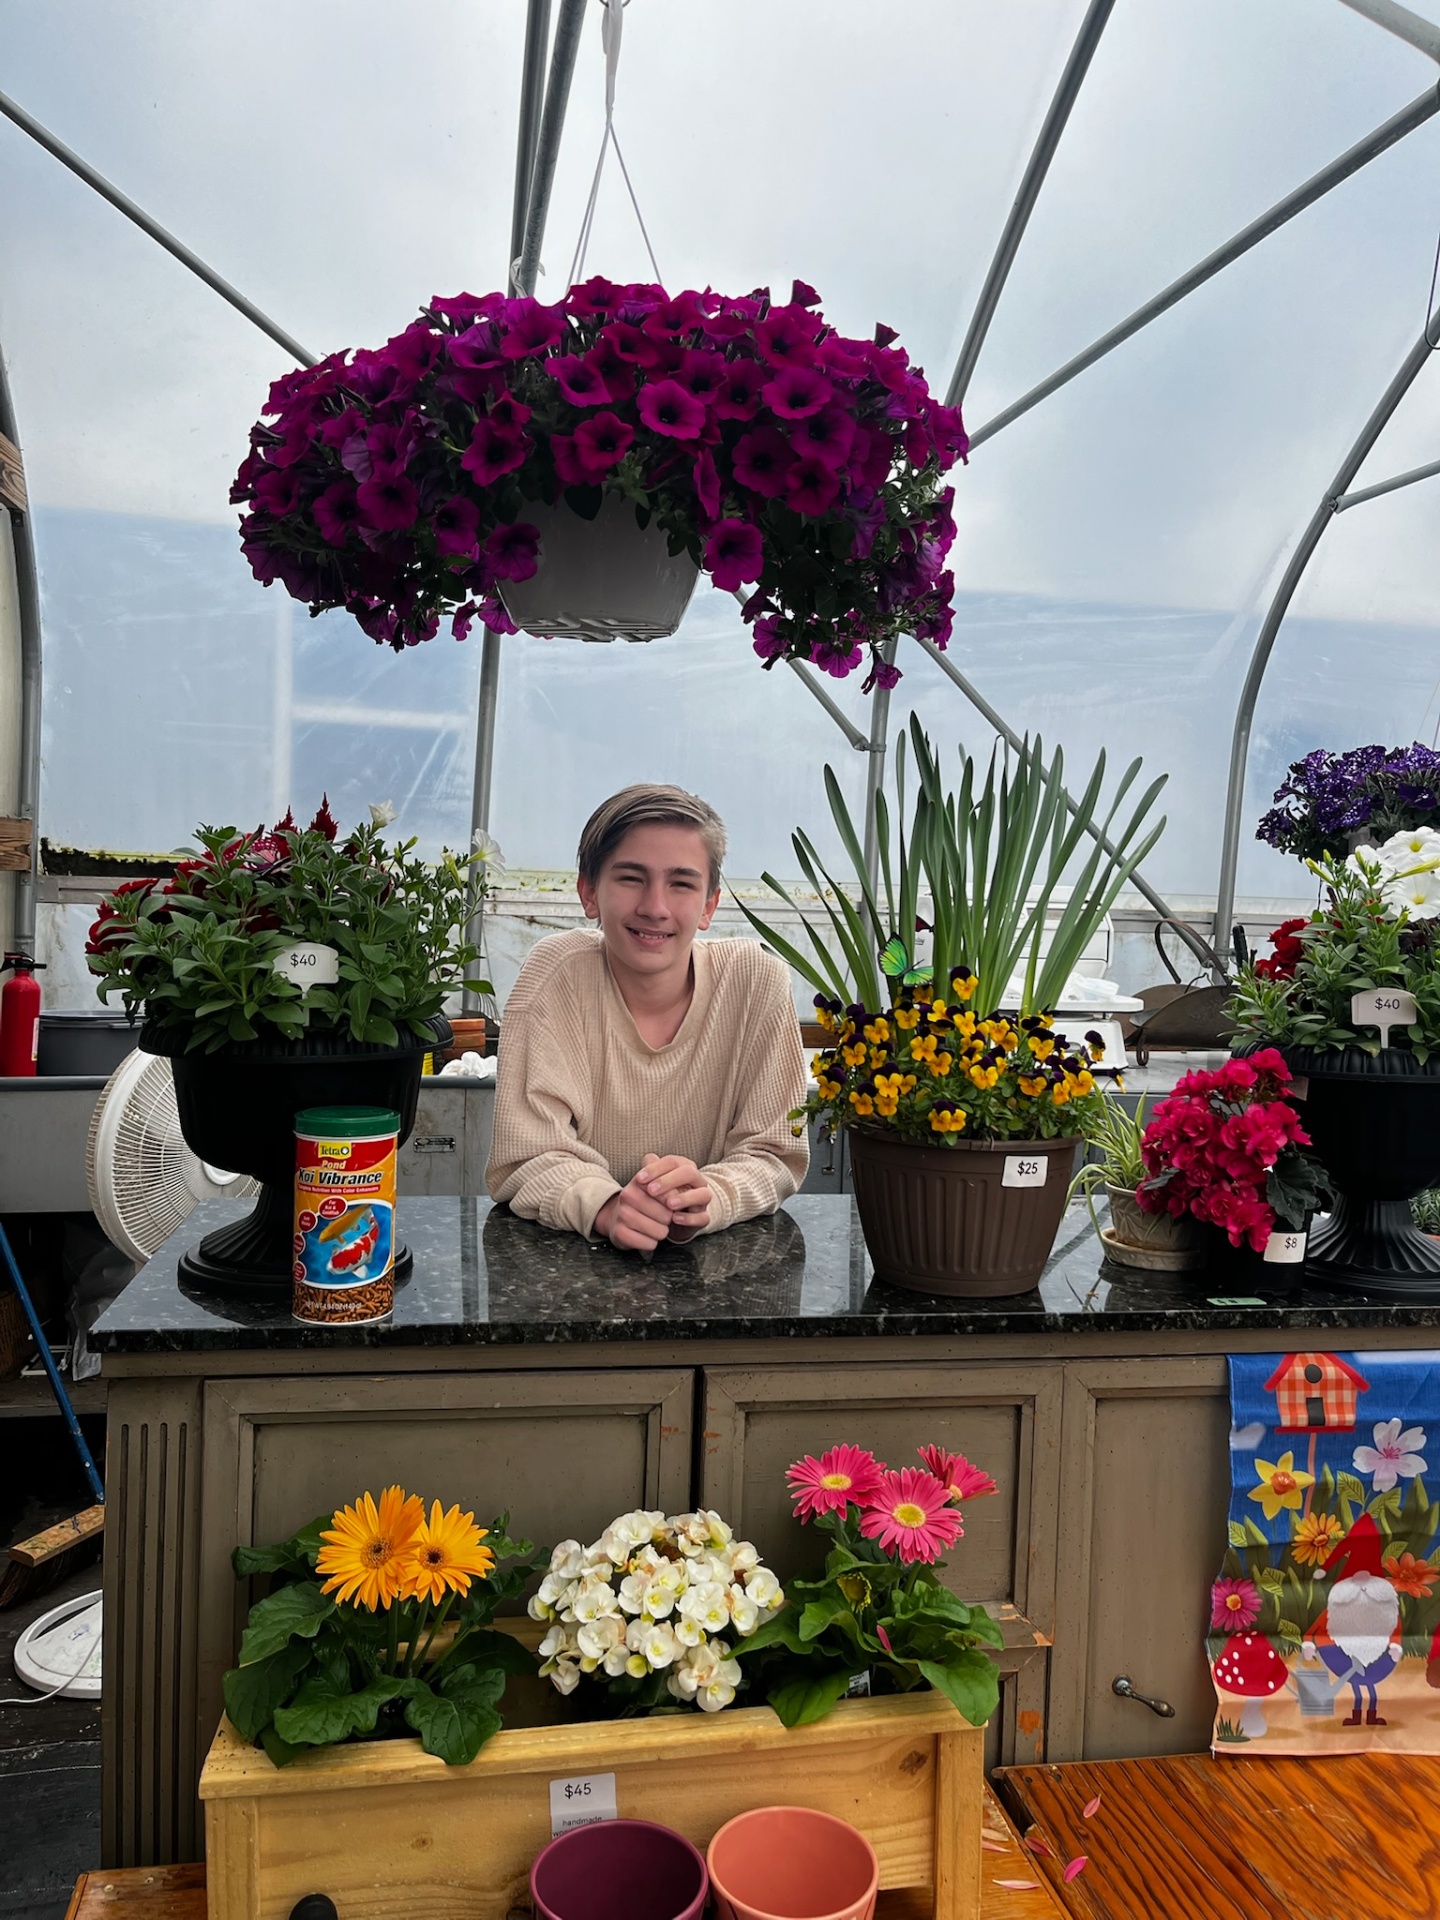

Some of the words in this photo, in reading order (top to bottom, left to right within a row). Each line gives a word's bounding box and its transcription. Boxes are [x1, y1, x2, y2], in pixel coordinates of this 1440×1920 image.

[290, 952, 316, 968] $40
[1374, 996, 1400, 1010] $40
[321, 1145, 341, 1155] Tetra
[322, 1160, 346, 1169] Pond
[1017, 1160, 1038, 1176] $25
[299, 1168, 315, 1183] Koi
[319, 1172, 382, 1184] Vibrance
[1284, 1236, 1297, 1249] $8
[564, 1782, 592, 1799] $45
[562, 1816, 602, 1826] handmade
